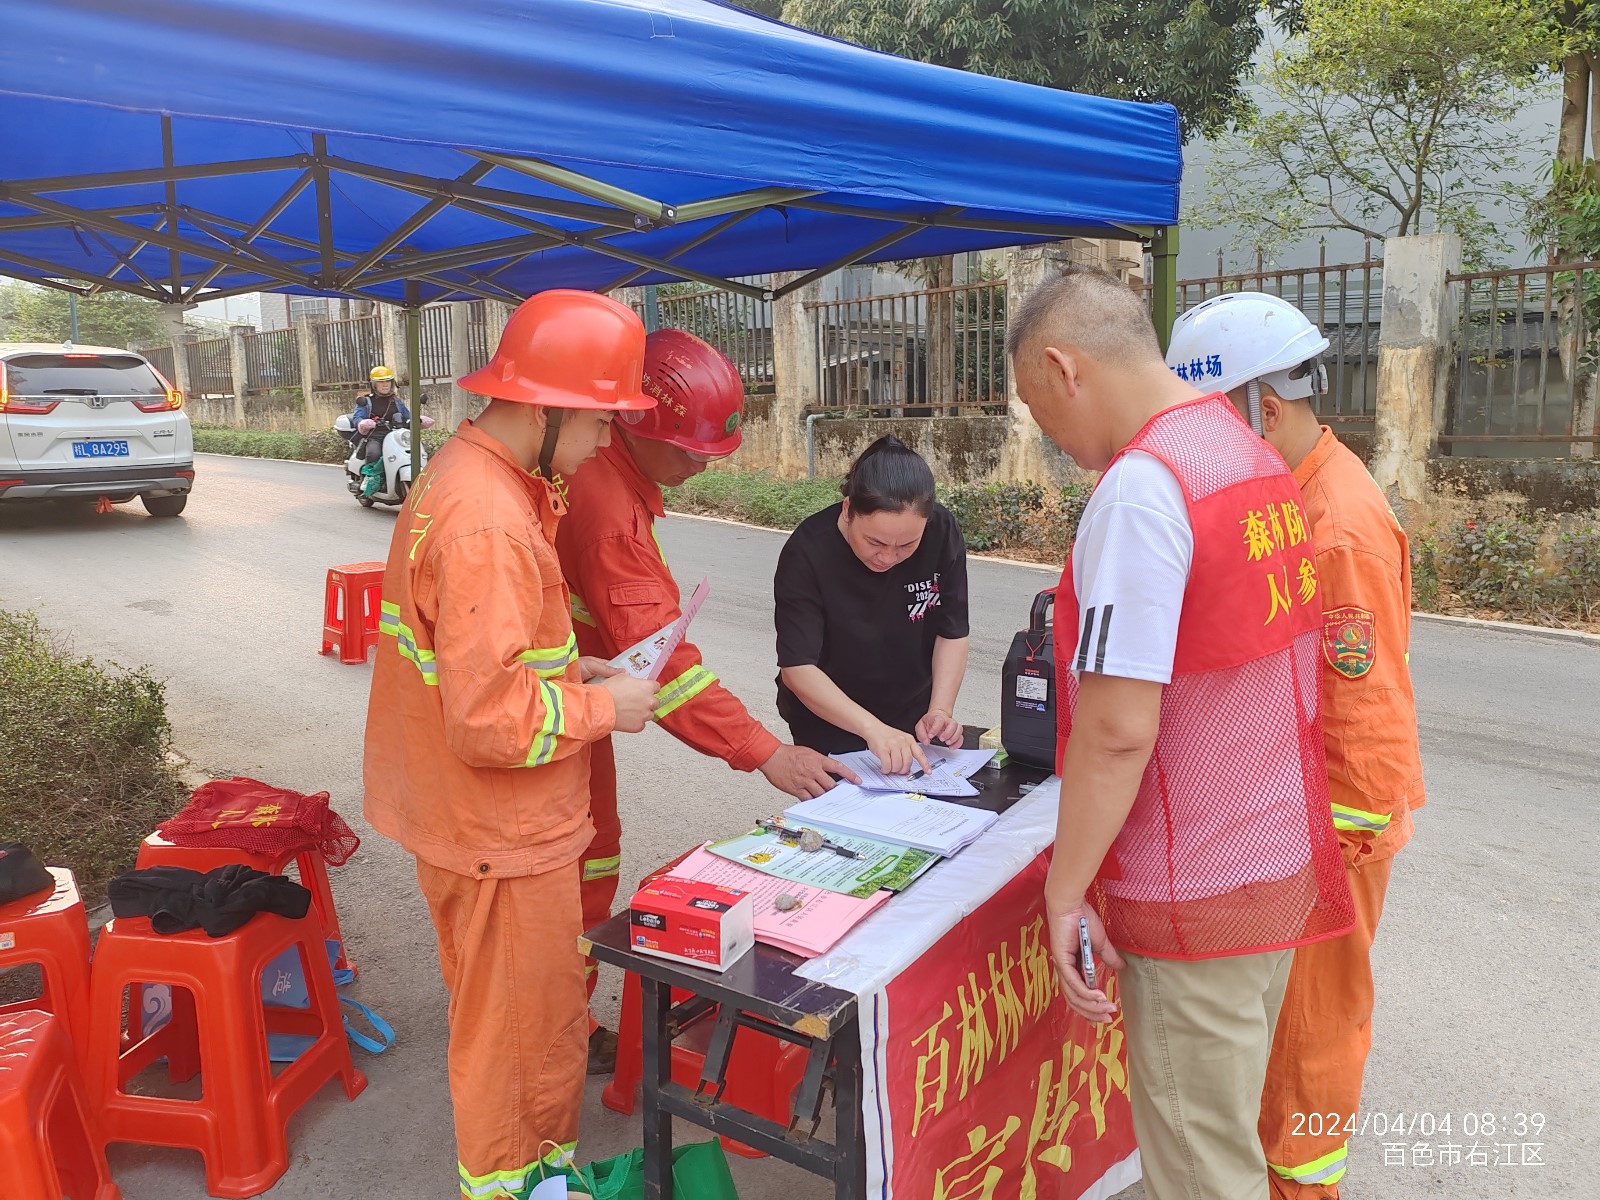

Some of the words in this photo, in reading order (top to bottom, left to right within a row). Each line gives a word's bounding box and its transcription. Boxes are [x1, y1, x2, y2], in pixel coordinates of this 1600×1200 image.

[1170, 354, 1223, 381] 林林场
[1239, 498, 1312, 562] 森林防
[911, 913, 1059, 1137] 百林林场
